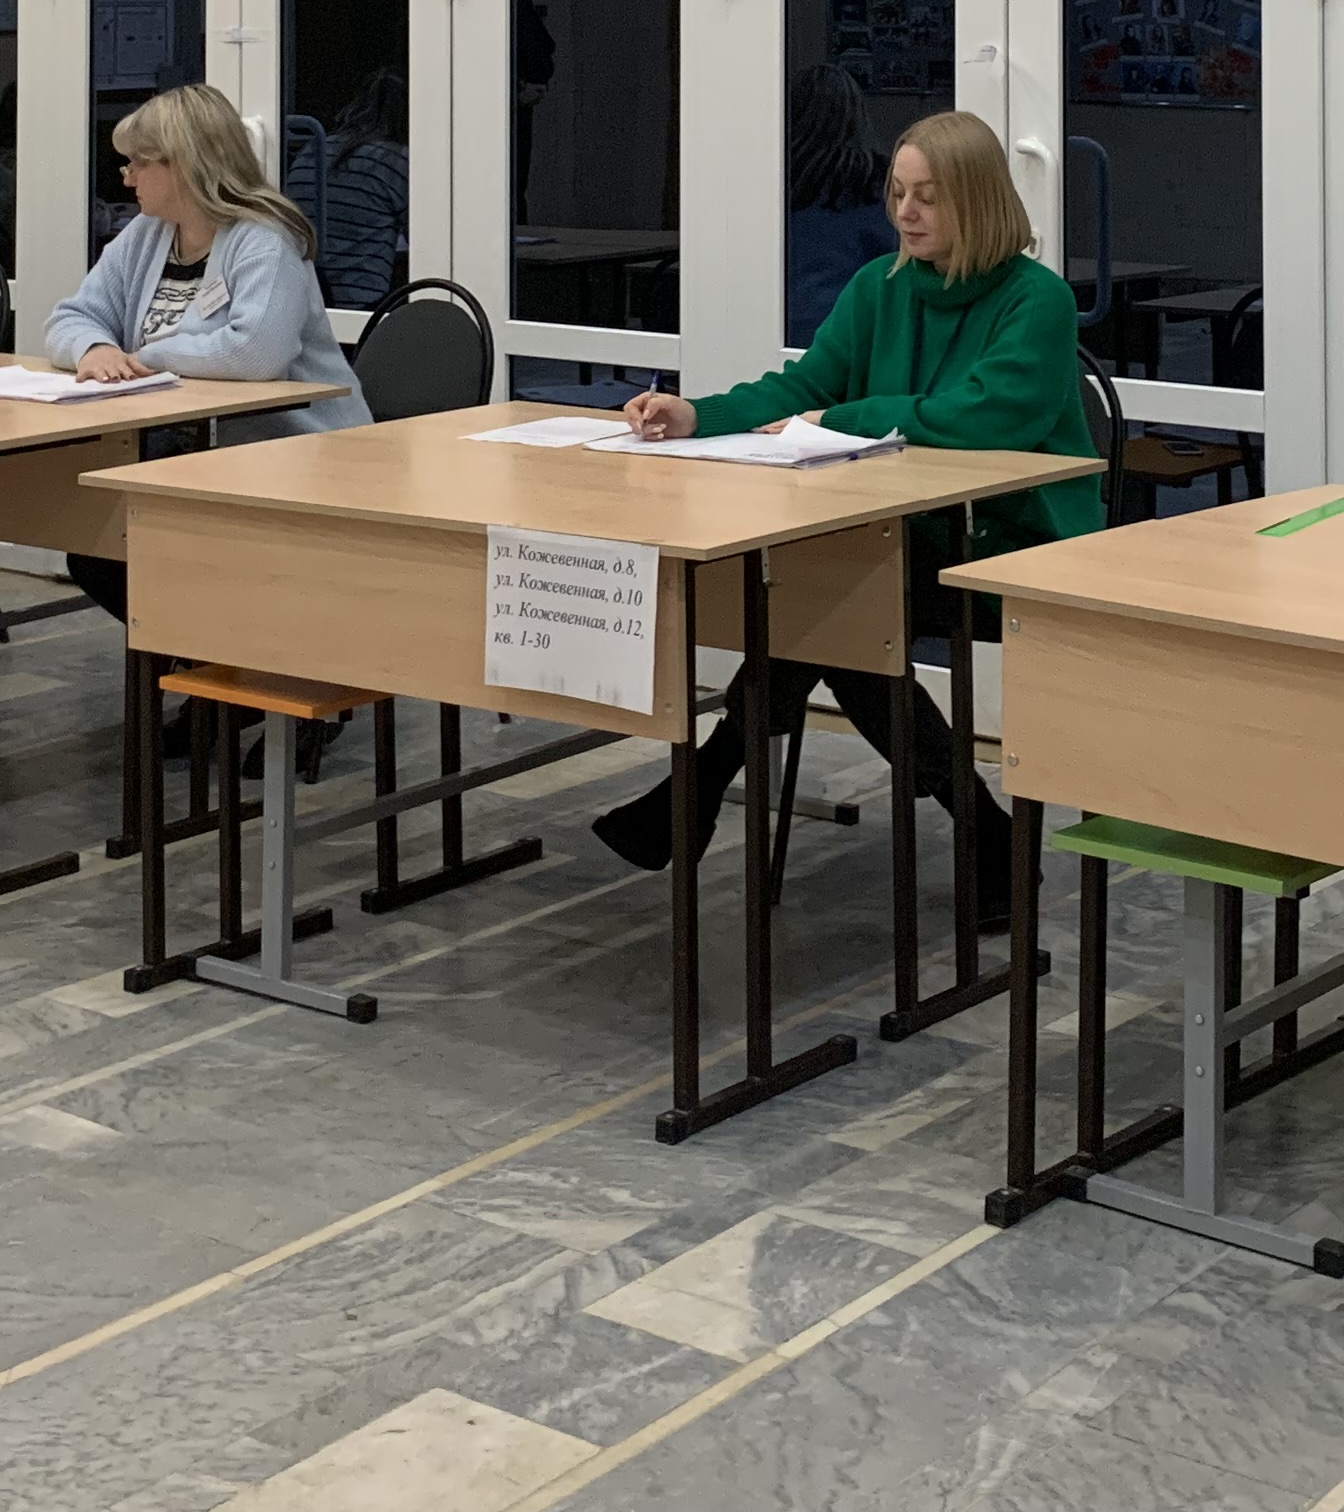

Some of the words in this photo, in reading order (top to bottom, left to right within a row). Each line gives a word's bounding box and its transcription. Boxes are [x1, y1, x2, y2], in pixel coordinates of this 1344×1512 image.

[494, 545, 513, 561] ул.
[518, 544, 609, 574] Кожевенная,
[613, 556, 638, 578] д.8,
[493, 574, 514, 589] ул.
[519, 573, 609, 603] Кожевенная,
[613, 587, 643, 607] д.10
[493, 602, 514, 618] ул.
[519, 601, 609, 633] Кожевенная,
[614, 616, 645, 640] д.12,
[494, 631, 514, 645] кв.
[520, 630, 551, 650] 1-30
